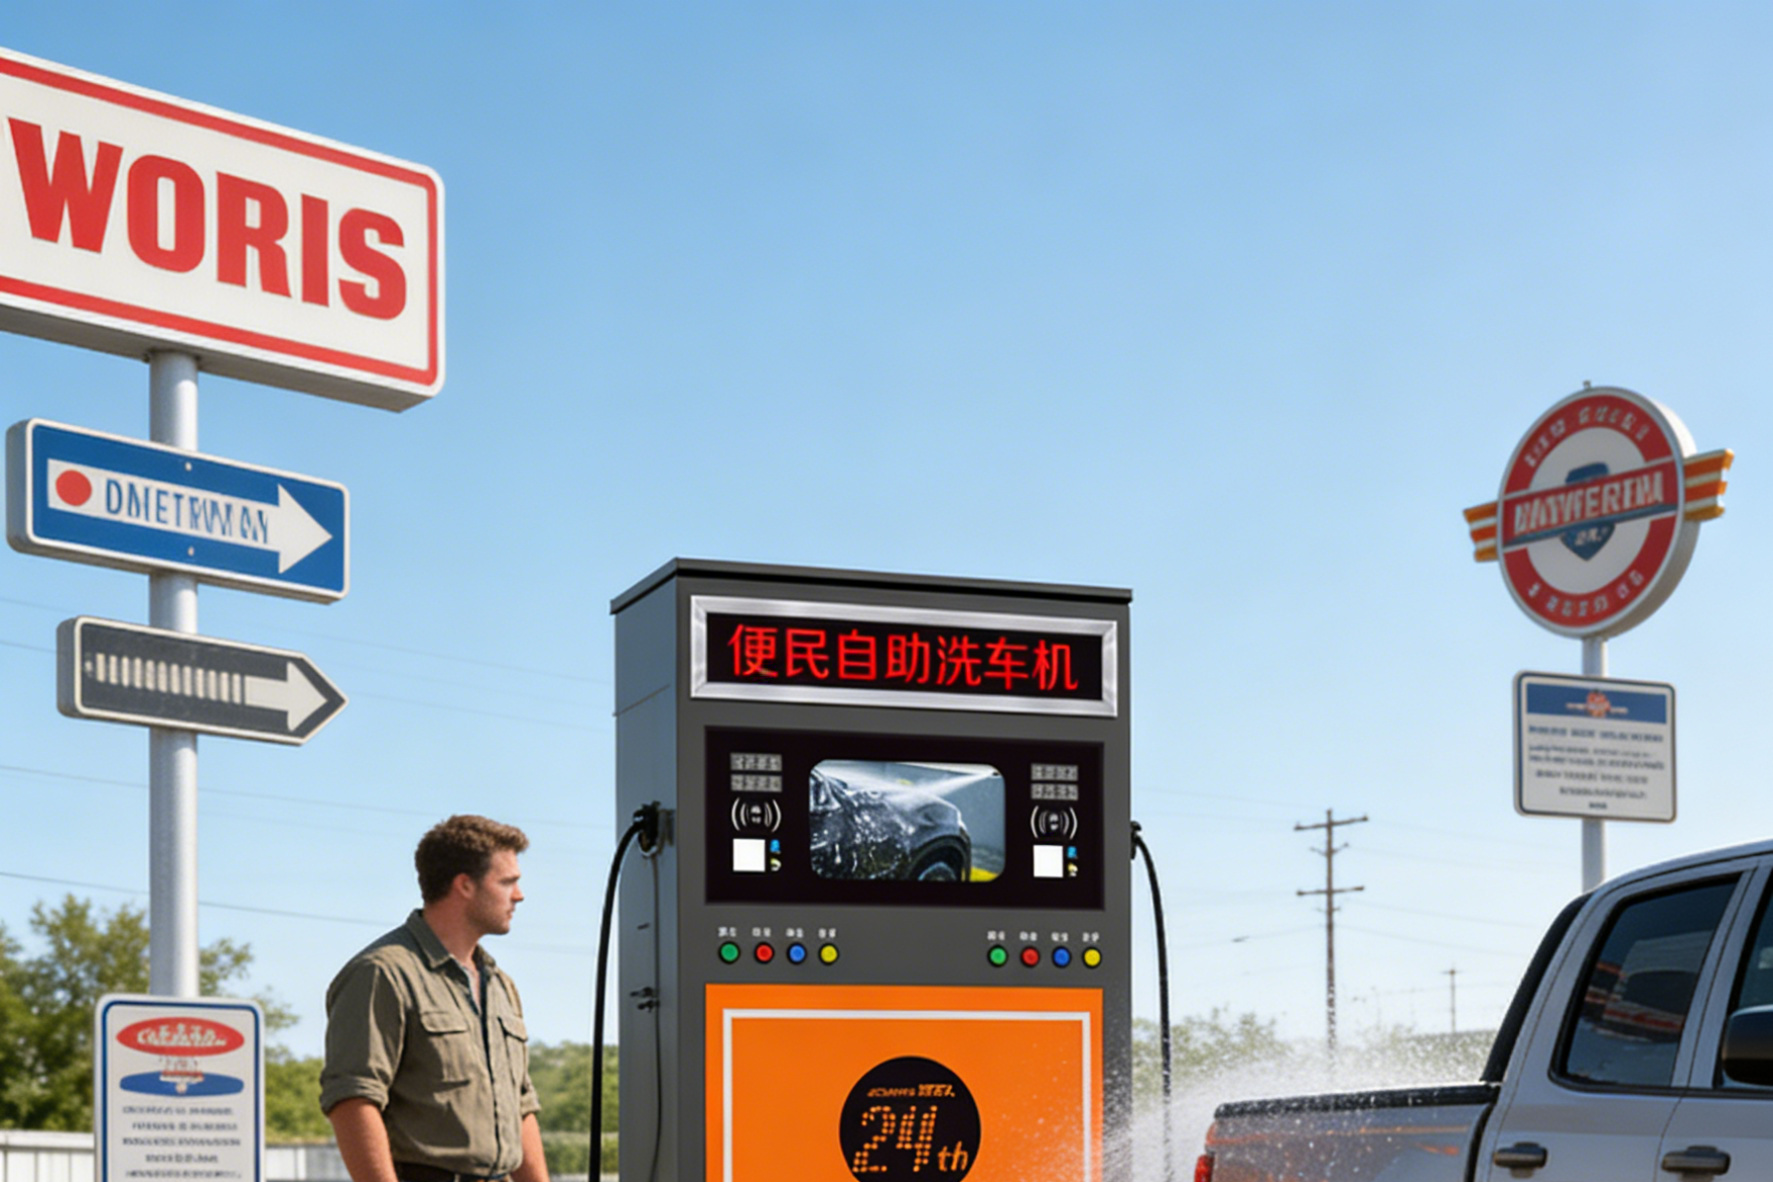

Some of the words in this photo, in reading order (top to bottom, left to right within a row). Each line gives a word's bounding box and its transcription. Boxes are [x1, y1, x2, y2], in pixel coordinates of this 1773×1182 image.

[8, 117, 407, 321] WORIS
[728, 624, 1078, 691] 便民自助洗车机
